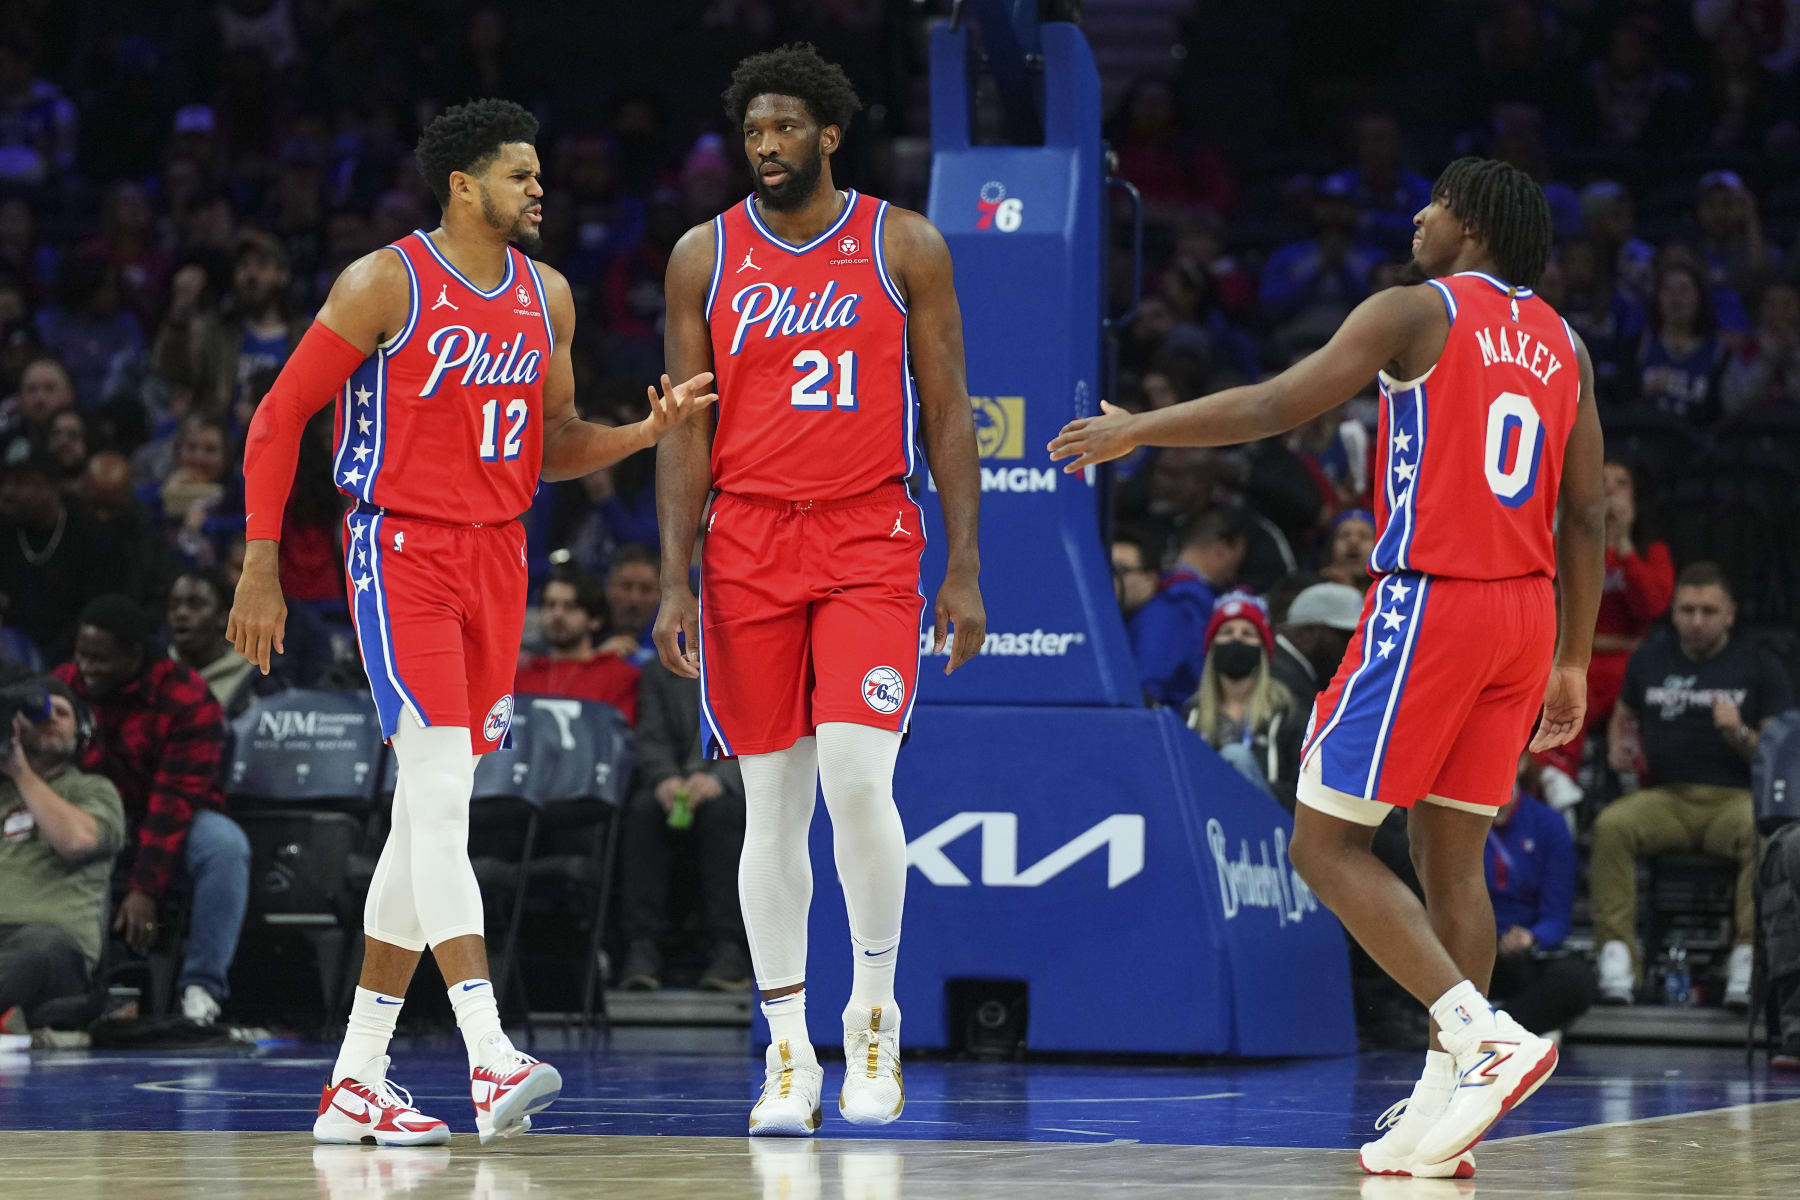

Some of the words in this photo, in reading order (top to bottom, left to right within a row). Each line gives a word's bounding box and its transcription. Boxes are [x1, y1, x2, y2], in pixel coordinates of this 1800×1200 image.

[976, 196, 1023, 233] 76
[829, 257, 869, 265] crypto.com
[729, 280, 862, 356] Phila
[418, 325, 542, 399] Phila
[790, 349, 859, 411] 21
[1474, 326, 1562, 386] MAXEY
[479, 398, 530, 462] 12
[1484, 391, 1546, 509] 0
[928, 467, 1056, 493] MGM
[867, 680, 899, 706] 76ers
[257, 710, 316, 741] NJM
